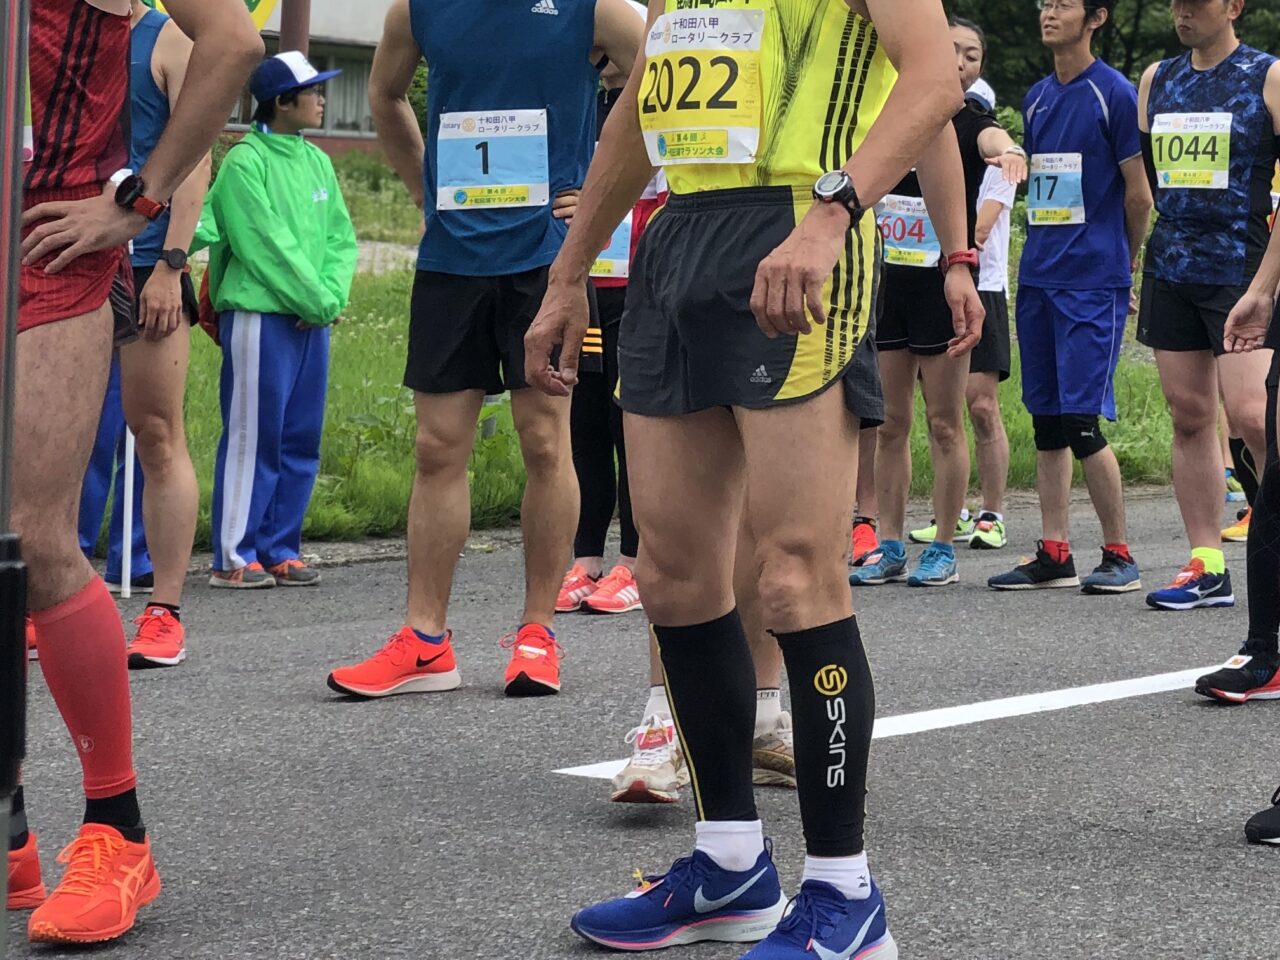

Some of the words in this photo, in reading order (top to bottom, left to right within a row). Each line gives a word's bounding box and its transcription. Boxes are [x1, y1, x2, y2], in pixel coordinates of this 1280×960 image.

[531, 6, 558, 16] adidas
[672, 17, 719, 30] 十和田八甲
[671, 31, 754, 44] ロータリークラブ
[642, 55, 740, 115] 2022
[478, 124, 540, 133] ロータリークラブ
[475, 141, 489, 175] 1
[1155, 135, 1219, 162] 1044
[1034, 175, 1059, 200] 17
[881, 215, 926, 244] 604
[826, 697, 847, 788] SKINS
